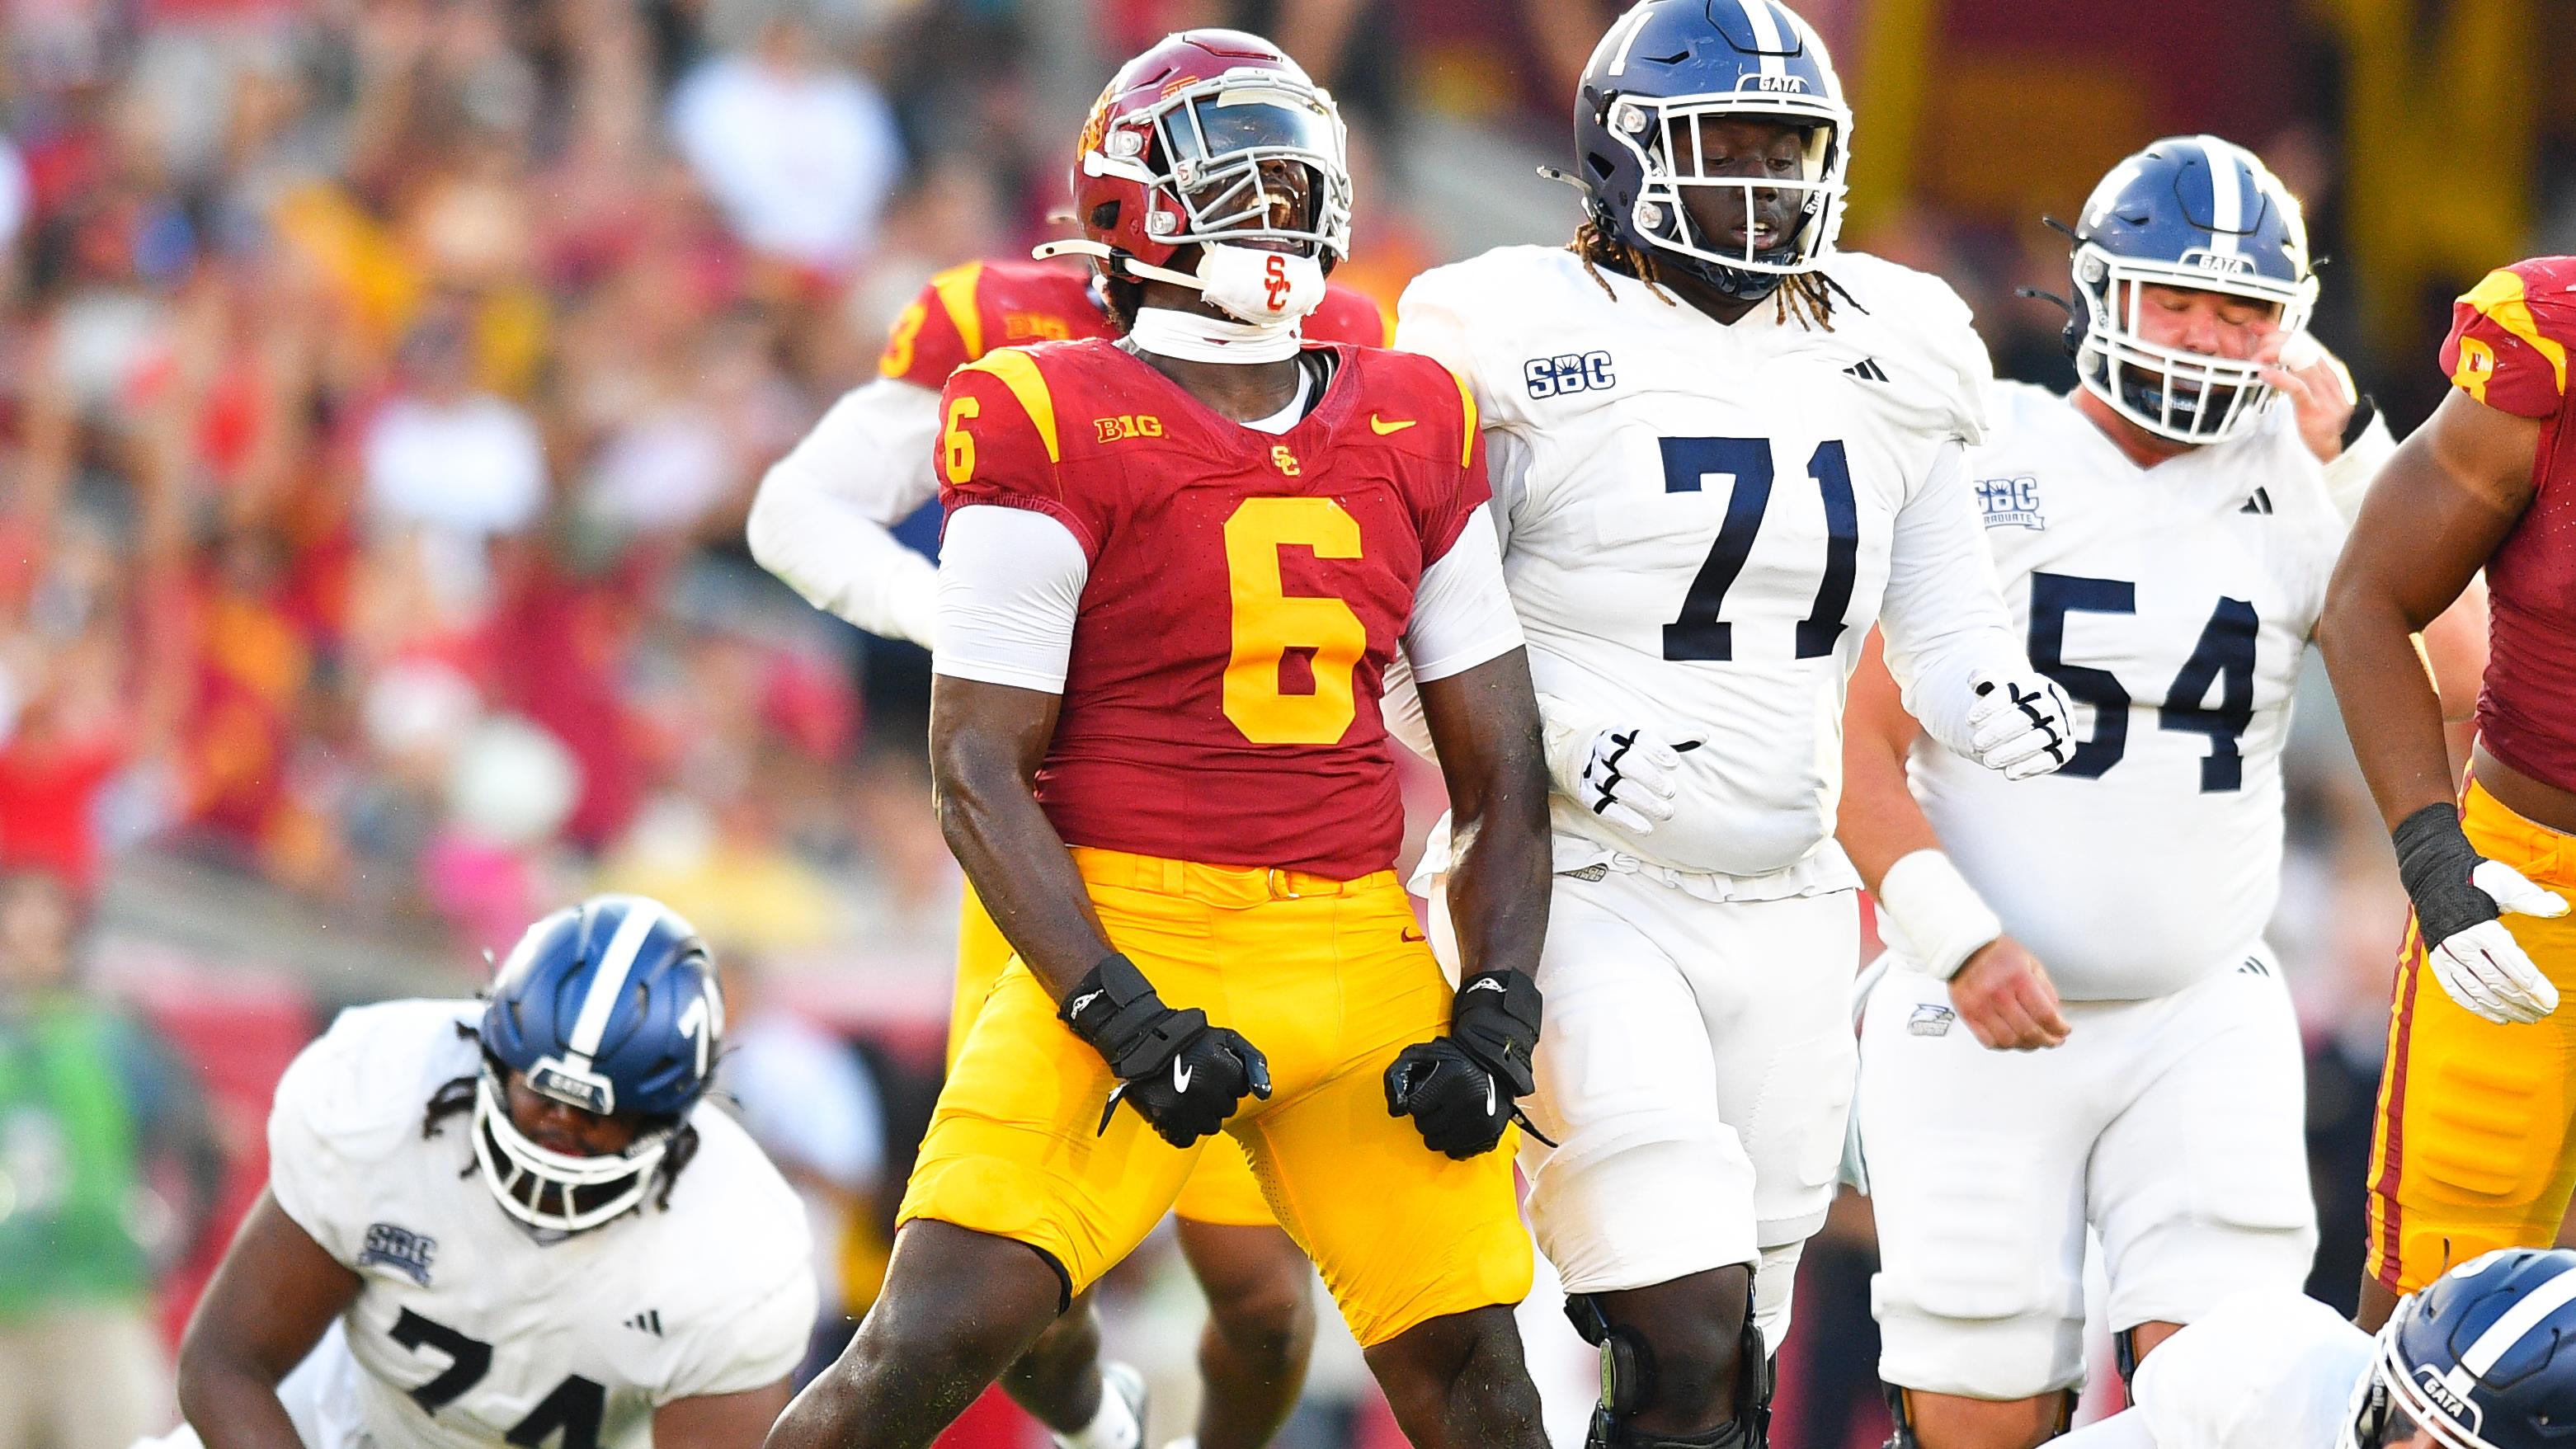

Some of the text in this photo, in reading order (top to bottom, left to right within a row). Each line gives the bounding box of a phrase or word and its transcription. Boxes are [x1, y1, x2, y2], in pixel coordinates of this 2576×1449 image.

[1758, 77, 1801, 93] GATA
[1264, 255, 1291, 311] SC
[2198, 256, 2243, 275] GATA
[1523, 350, 1616, 400] SBC
[944, 396, 980, 485] 6
[1271, 445, 1301, 476] SC
[1983, 512, 2032, 525] RADUATE
[1656, 436, 1859, 661] 71
[1222, 496, 1367, 745] 6
[2026, 570, 2260, 796] 54
[387, 1305, 607, 1449] 74
[2423, 1377, 2465, 1418] GATA
